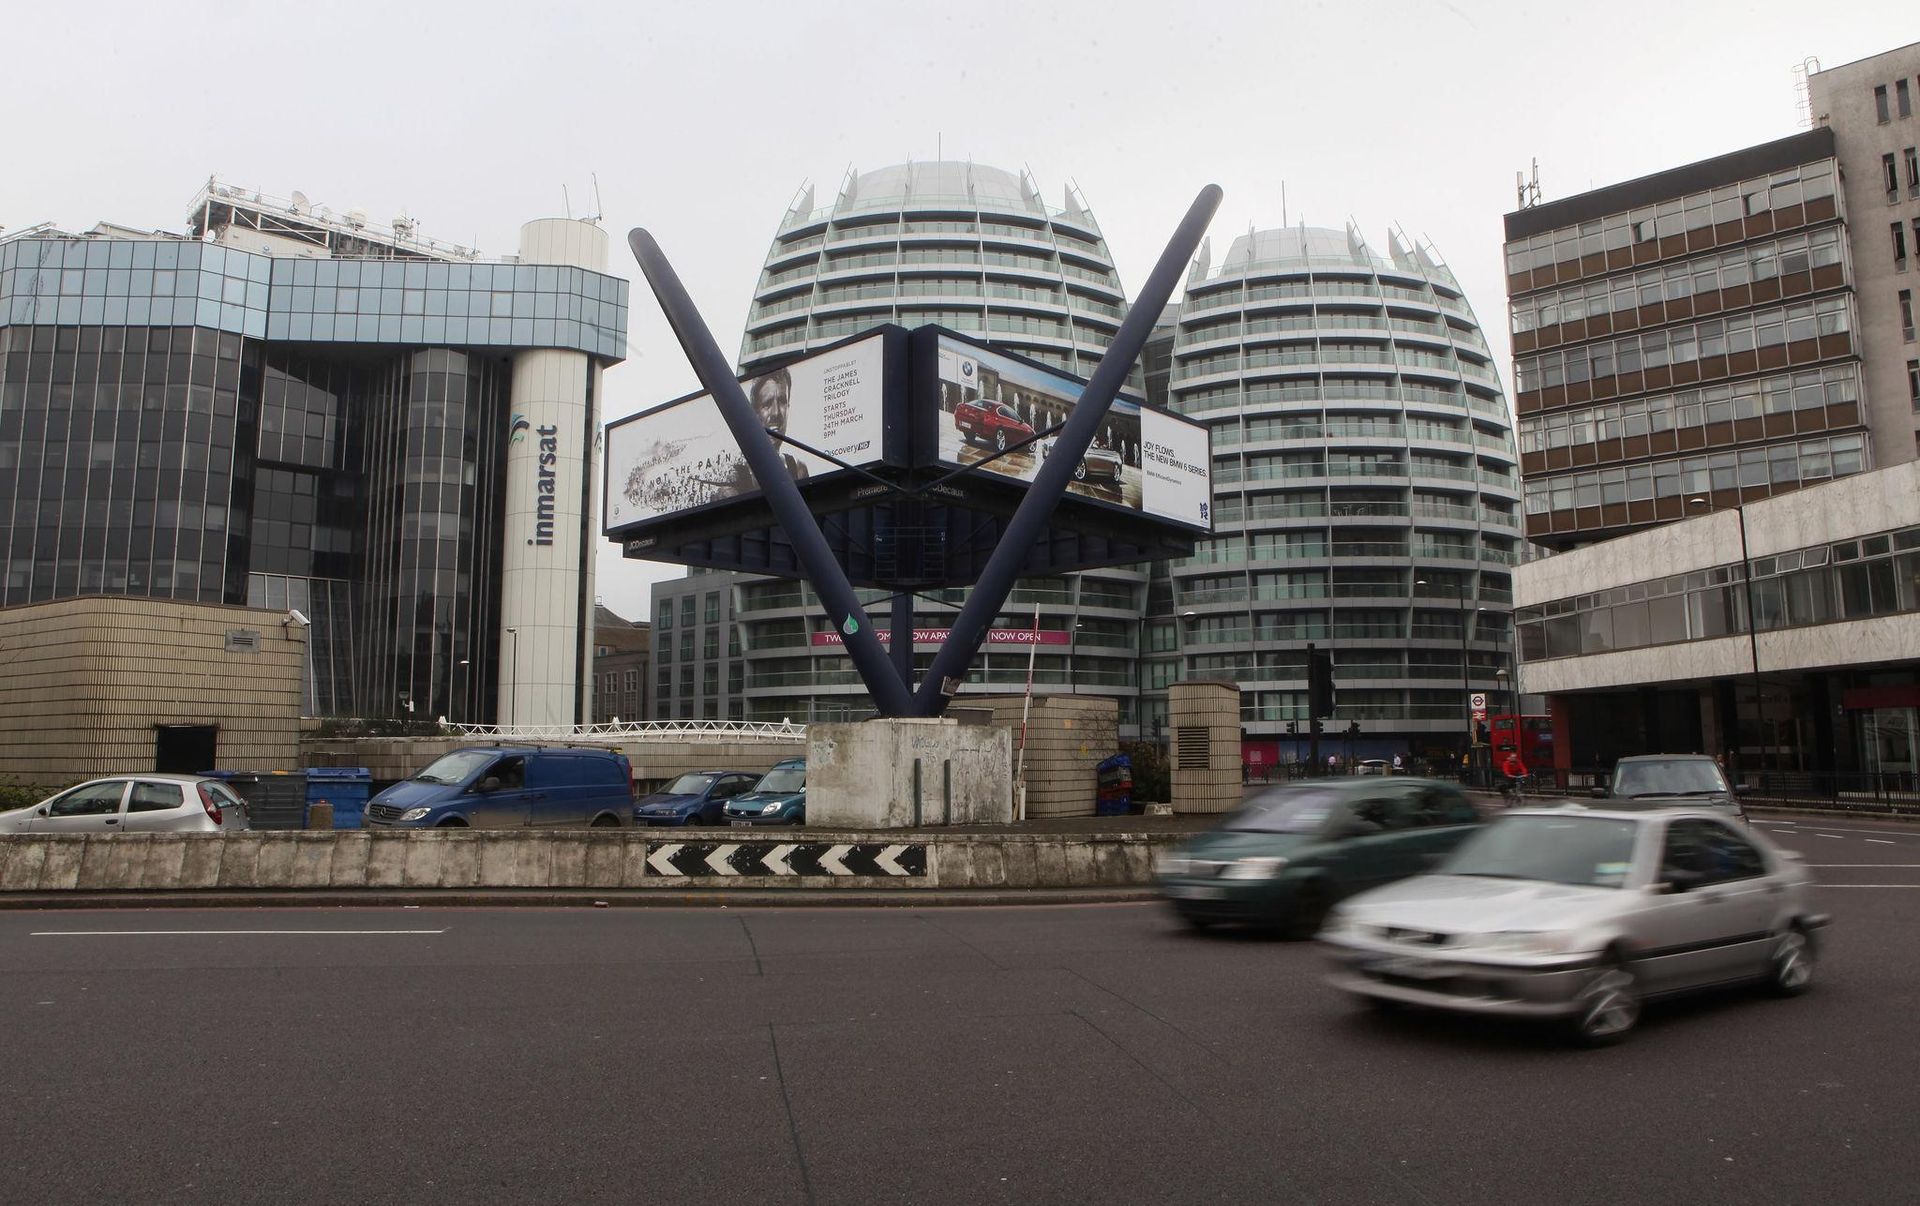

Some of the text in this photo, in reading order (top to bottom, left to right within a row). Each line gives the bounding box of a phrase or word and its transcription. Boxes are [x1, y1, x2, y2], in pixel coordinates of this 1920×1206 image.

[824, 369, 858, 385] THE JAMES
[823, 377, 861, 394] CRACKNELL
[824, 389, 850, 401] TRILOGY
[823, 401, 847, 414] STARTS
[824, 406, 857, 422] THURSDAY
[823, 413, 864, 431] 24TH MARCH
[823, 430, 836, 439] 9PM
[1143, 441, 1176, 458] JOY FLOWS.
[1143, 449, 1208, 478] THE NEW BMW 6 SERIES.
[527, 424, 558, 546] inmarsat
[991, 632, 1015, 641] NOW
[1017, 632, 1041, 641] OPEN
